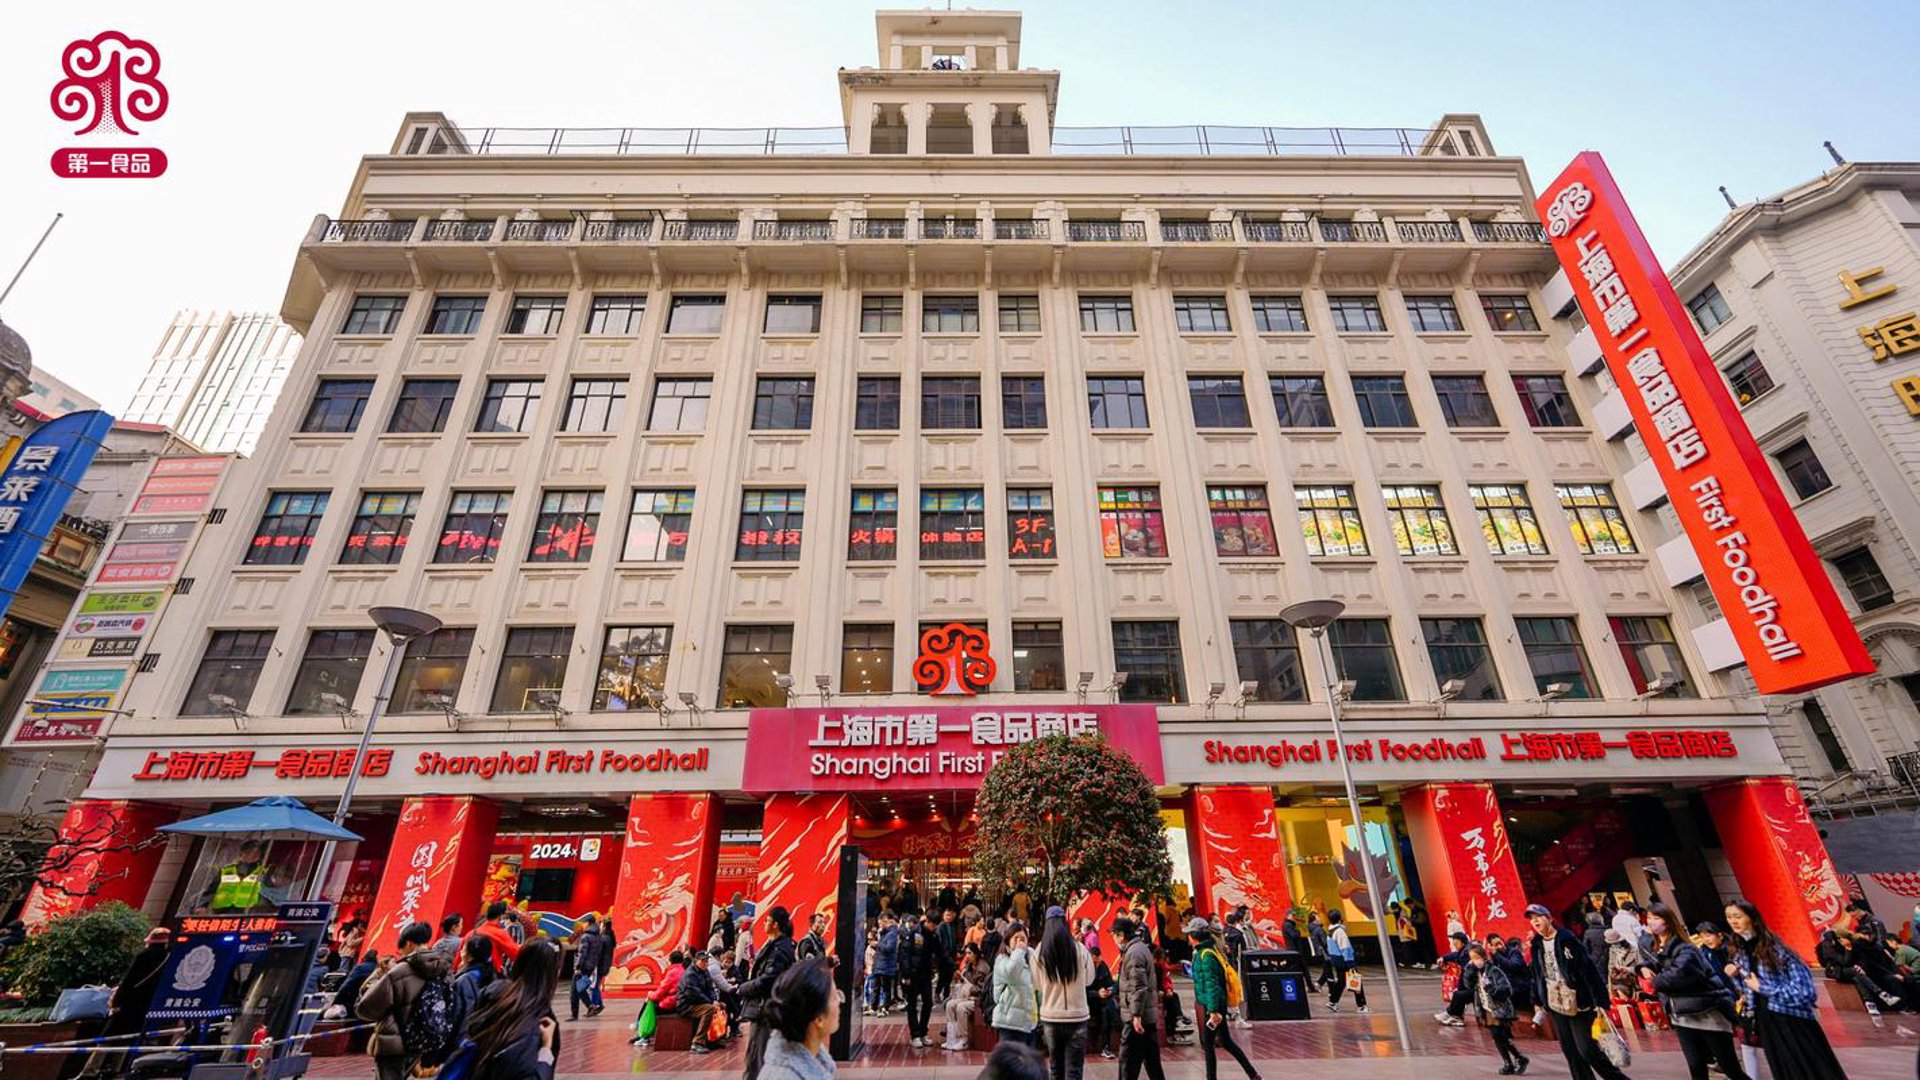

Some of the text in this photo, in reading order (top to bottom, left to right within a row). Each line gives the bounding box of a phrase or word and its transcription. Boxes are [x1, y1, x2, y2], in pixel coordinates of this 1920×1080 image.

[1574, 229, 1708, 471] 上海市第一食品商店
[1015, 517, 1048, 534] 3F
[1690, 475, 1803, 663] First Foodhall
[809, 713, 1098, 747] 上海市第一食品商店
[1500, 730, 1738, 760] 上海市第一食品商店
[132, 749, 393, 780] 上海市第一食品商店
[416, 748, 709, 778] Shanghai First Foodhall
[811, 752, 931, 779] Shanghai
[939, 752, 985, 774] First
[1204, 737, 1487, 768] Shanghai Frst Foodhall
[530, 843, 571, 859] 2024
